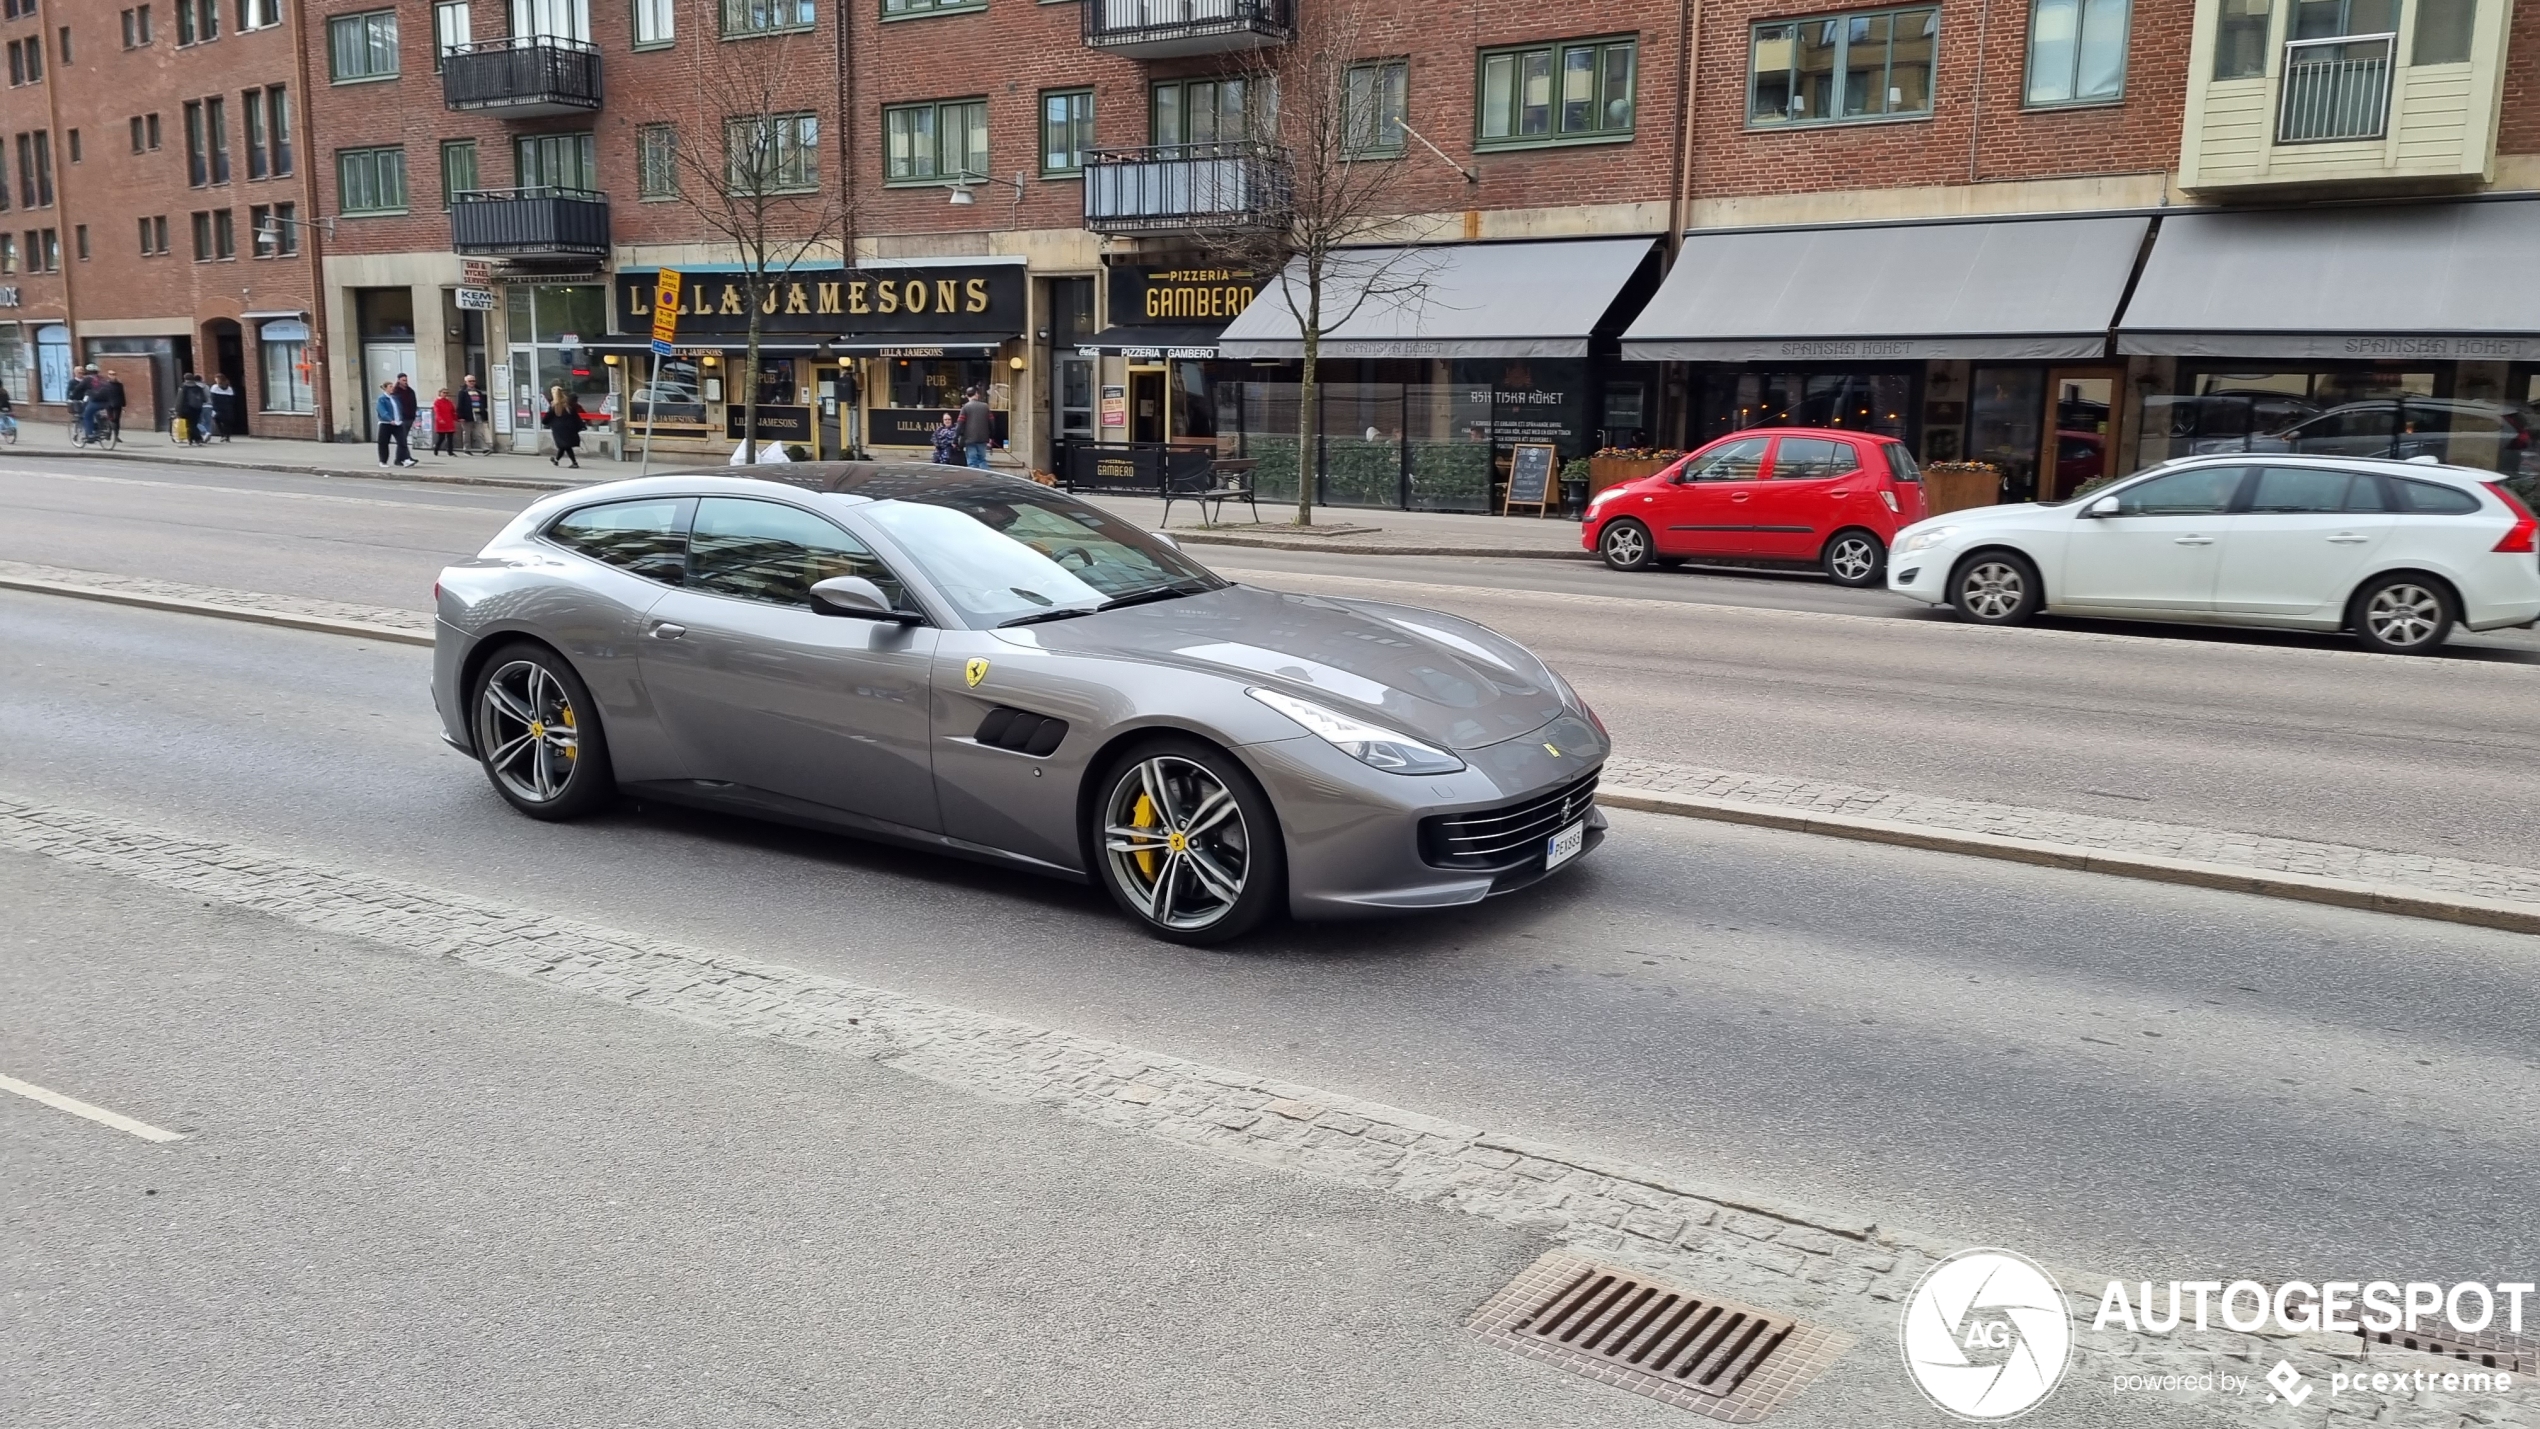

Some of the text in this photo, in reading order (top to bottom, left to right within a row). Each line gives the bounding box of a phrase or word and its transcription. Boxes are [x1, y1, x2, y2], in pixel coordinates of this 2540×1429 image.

[1169, 269, 1230, 282] PIZZERIA
[461, 290, 492, 301] KEM
[761, 278, 989, 316] JAMESONS
[1781, 342, 1856, 355] SPANSKA
[2344, 338, 2448, 353] SPANSKA
[879, 348, 944, 357] LILLA JAMESONS
[1121, 348, 1214, 359] PIZZERIA GAMBERO
[658, 371, 675, 382] PUB
[757, 373, 776, 384] PUB
[926, 375, 947, 387] PUB
[757, 418, 798, 428] JAMESONS
[897, 421, 922, 431] LILLA
[1097, 464, 1134, 477] GAMBERO
